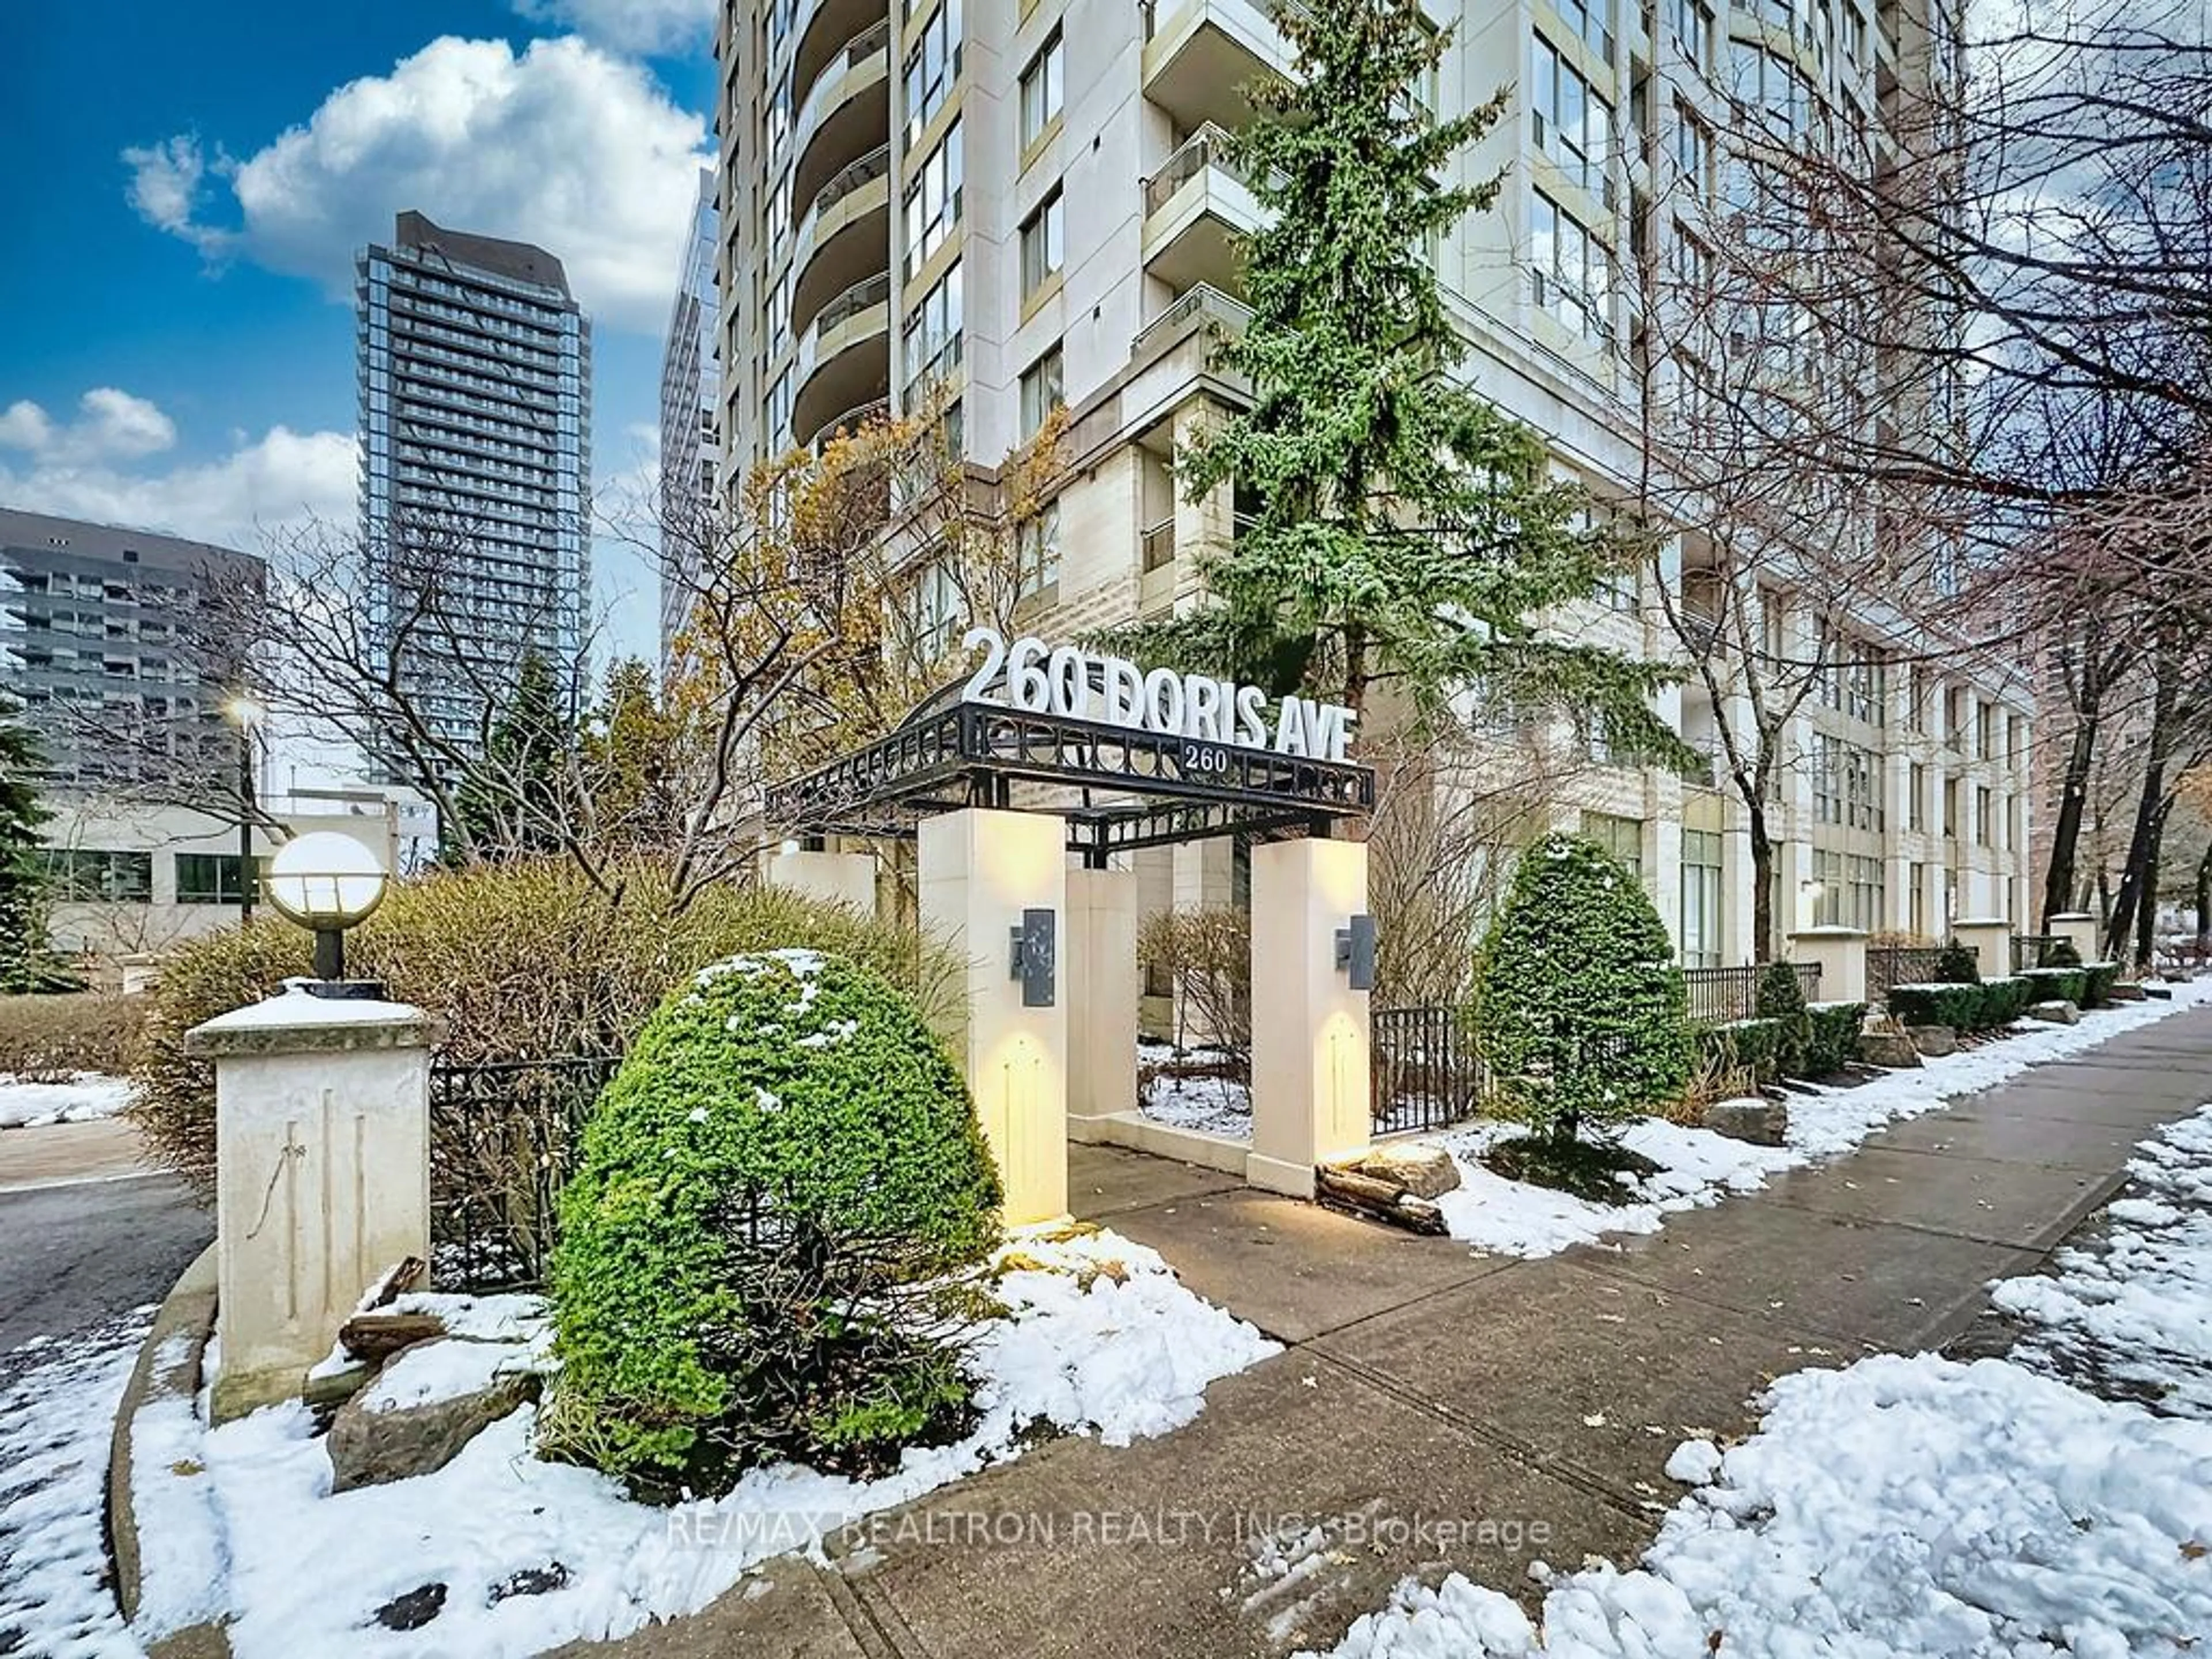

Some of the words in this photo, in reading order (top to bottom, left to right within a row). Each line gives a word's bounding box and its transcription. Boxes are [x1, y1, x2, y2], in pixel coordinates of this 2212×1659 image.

[961, 626, 1088, 718] 260
[1104, 656, 1267, 748] DORIS
[1275, 695, 1357, 765] AVE
[1185, 745, 1226, 772] 260
